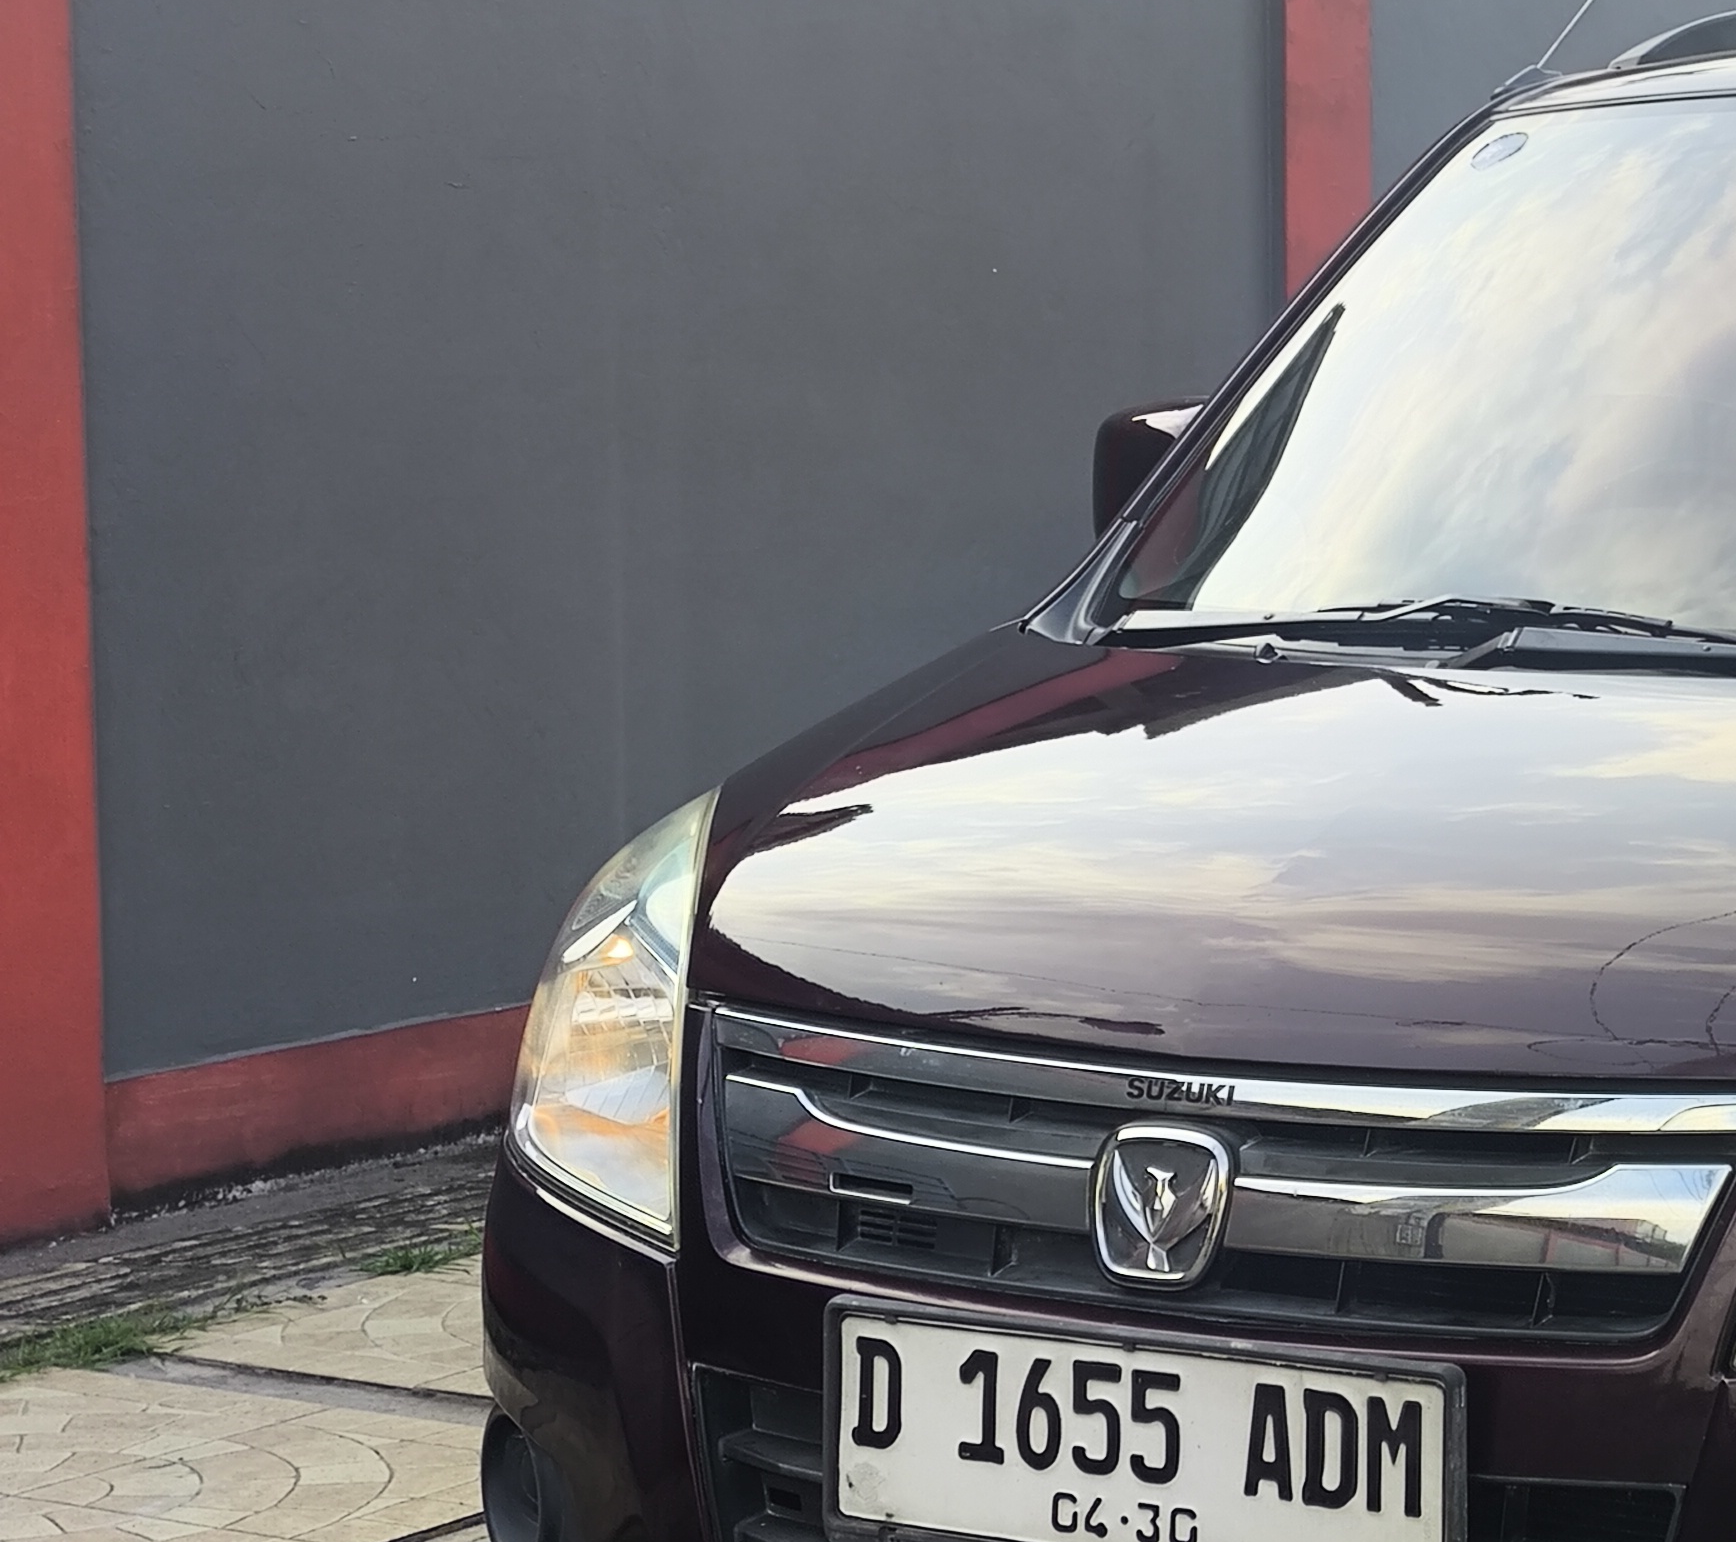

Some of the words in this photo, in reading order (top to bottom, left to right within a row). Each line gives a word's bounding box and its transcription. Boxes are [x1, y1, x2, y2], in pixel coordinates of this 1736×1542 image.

[1126, 1077, 1236, 1107] SUZUKI
[851, 1335, 902, 1450] D
[957, 1349, 1181, 1485] 1655
[1243, 1382, 1423, 1519] ADM
